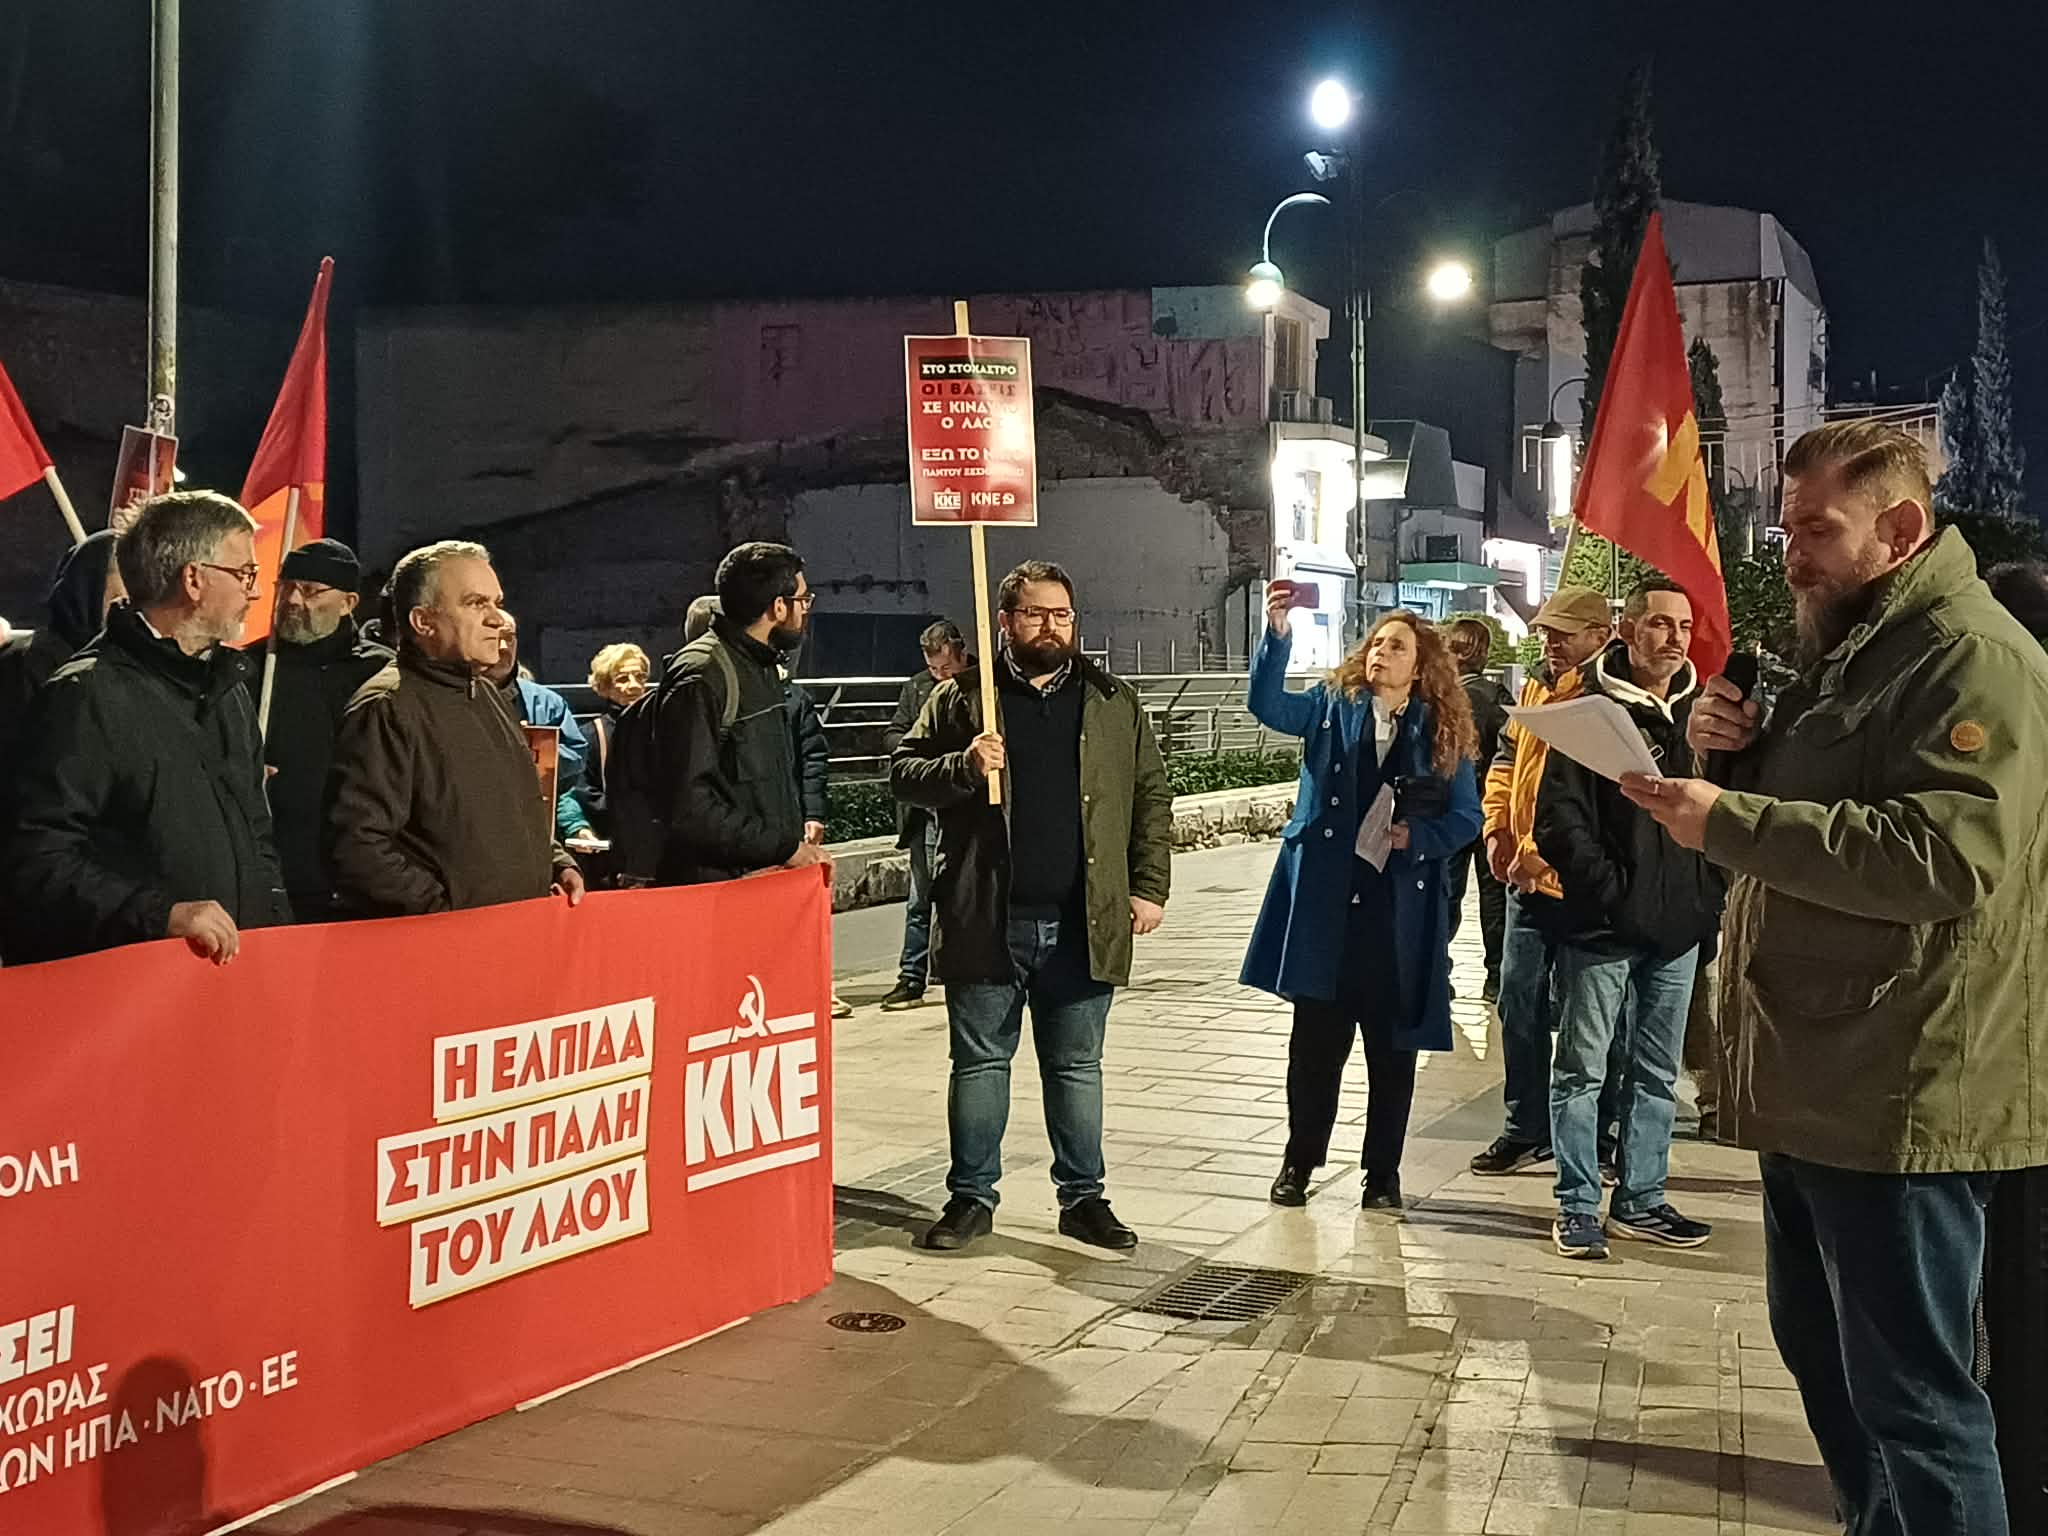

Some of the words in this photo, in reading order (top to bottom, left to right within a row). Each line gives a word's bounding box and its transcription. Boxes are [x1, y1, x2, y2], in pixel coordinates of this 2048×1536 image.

[922, 364, 946, 374] ΣΤΟ
[922, 383, 942, 395] ΟΙ
[922, 401, 942, 413] ΣΕ
[941, 417, 954, 429] Ο
[961, 417, 1004, 429] ΛΑΟ
[921, 448, 954, 460] ΕΞΩ
[957, 448, 979, 460] ΤΟ
[936, 495, 961, 507] ΚΚΕ
[971, 492, 1000, 505] ΚΝΕ
[443, 1043, 478, 1103] Η
[491, 1009, 644, 1093] ΕΛΠΙΔΑ
[686, 1037, 819, 1166] ΚΚΕ
[385, 1120, 514, 1207] ΣΤΗΝ
[528, 1089, 641, 1168] ΠΑΛΗ
[420, 1207, 514, 1286] ΤΟΥ
[520, 1168, 637, 1254] ΛΑΟΥ
